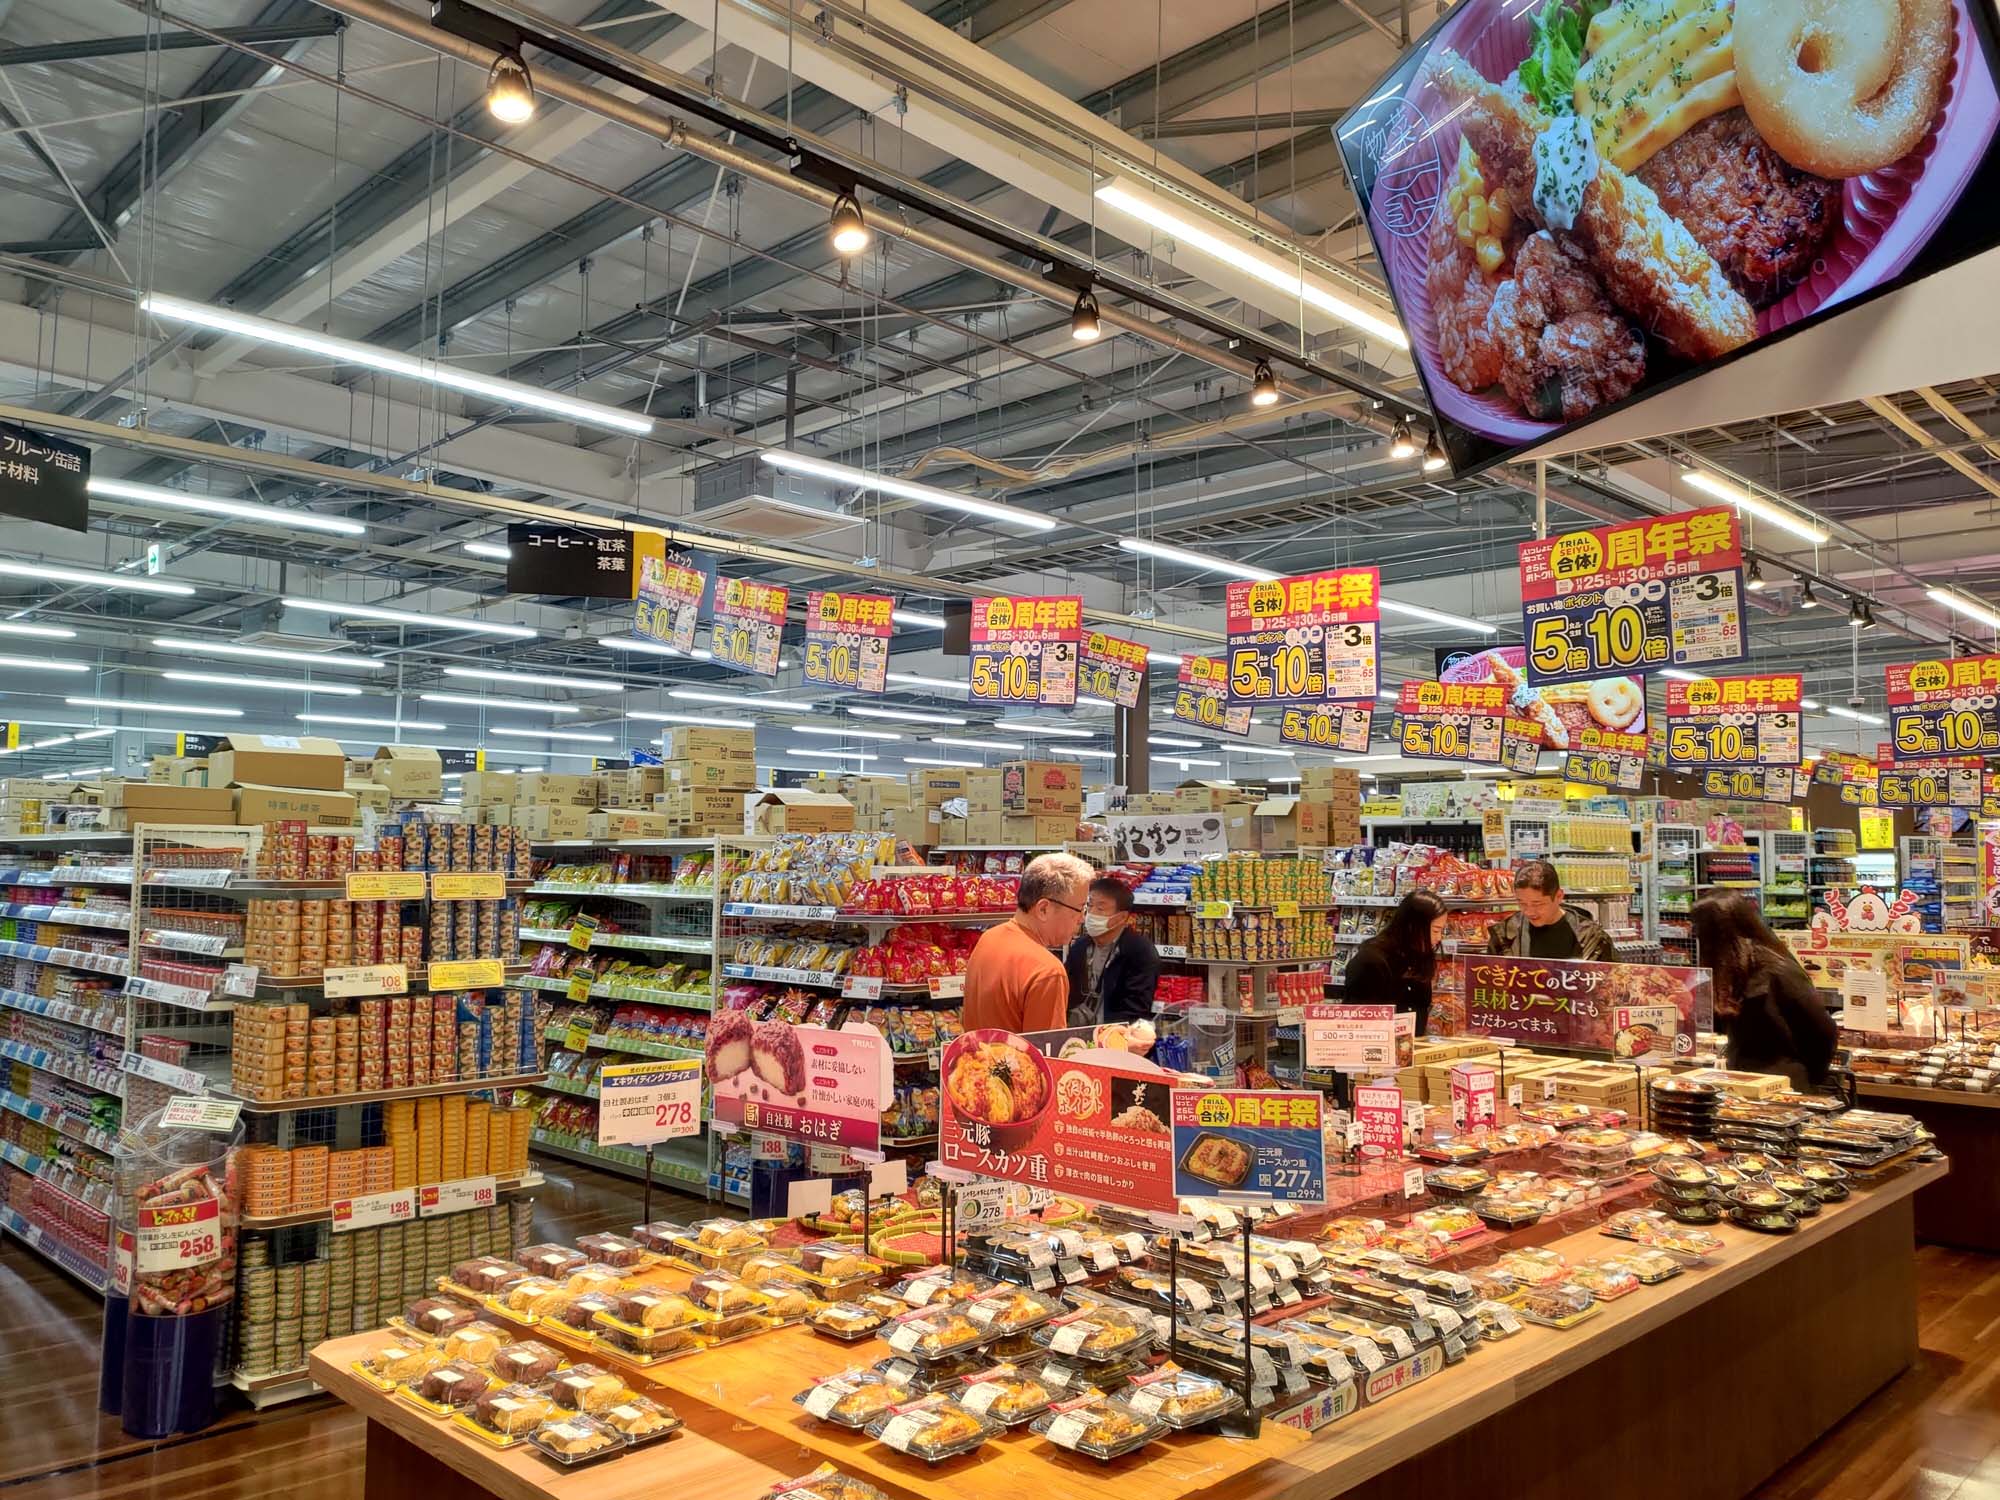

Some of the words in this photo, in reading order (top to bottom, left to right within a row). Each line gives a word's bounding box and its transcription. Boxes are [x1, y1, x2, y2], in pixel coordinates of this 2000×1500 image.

[3, 435, 82, 472] フルーツ缶詰
[528, 534, 626, 553] コーヒー・紅茶
[1559, 538, 1590, 549] TRIAL
[1606, 512, 1732, 570] 周年祭
[597, 556, 625, 572] 茶葉
[668, 549, 693, 568] スナック
[1557, 553, 1597, 573] 合体!
[744, 585, 786, 614] 周年祭
[1288, 574, 1372, 614] 周年祭
[840, 598, 891, 625] 周年祭
[1014, 600, 1078, 629] 周年祭
[1254, 598, 1282, 613] 合体!
[1106, 640, 1148, 664] 周年祭
[1722, 678, 1798, 703] 周年祭
[1915, 676, 1945, 688] 合体!
[1445, 685, 1505, 707] 周年祭
[1691, 692, 1717, 702] 合体!
[1602, 732, 1647, 751] 周年祭
[807, 908, 822, 918] 128
[1812, 928, 1828, 950] 5
[1162, 946, 1174, 956] 98
[381, 976, 401, 989] 108
[805, 973, 821, 984] 128
[1471, 964, 1603, 993] できたてのピザ
[1472, 989, 1599, 1018] 具材とソースにも
[1471, 1013, 1558, 1035] こだわってます。
[852, 1040, 875, 1049] TRIAL
[1468, 1046, 1489, 1054] PIZZA
[1425, 1053, 1447, 1061] PIZZA
[611, 1071, 691, 1087] エキサイティングプライス
[655, 1102, 692, 1127] 278
[1059, 1097, 1104, 1114] ポイント
[1234, 1098, 1318, 1127] 周年祭
[766, 1112, 793, 1129] 自社製
[1200, 1112, 1229, 1124] 合体!
[1362, 1110, 1397, 1124] ご予約
[800, 1116, 843, 1141] おはぎ
[944, 1119, 992, 1147] 三元豚
[762, 1140, 782, 1153] 138
[944, 1143, 1049, 1184] ロースカツ重
[1274, 1169, 1311, 1188] 277
[1312, 1180, 1321, 1189] 円
[474, 1188, 492, 1201] 188
[1297, 1189, 1316, 1199] 299
[390, 1200, 410, 1215] 128
[982, 1206, 1001, 1219] 278
[180, 1234, 215, 1259] 258
